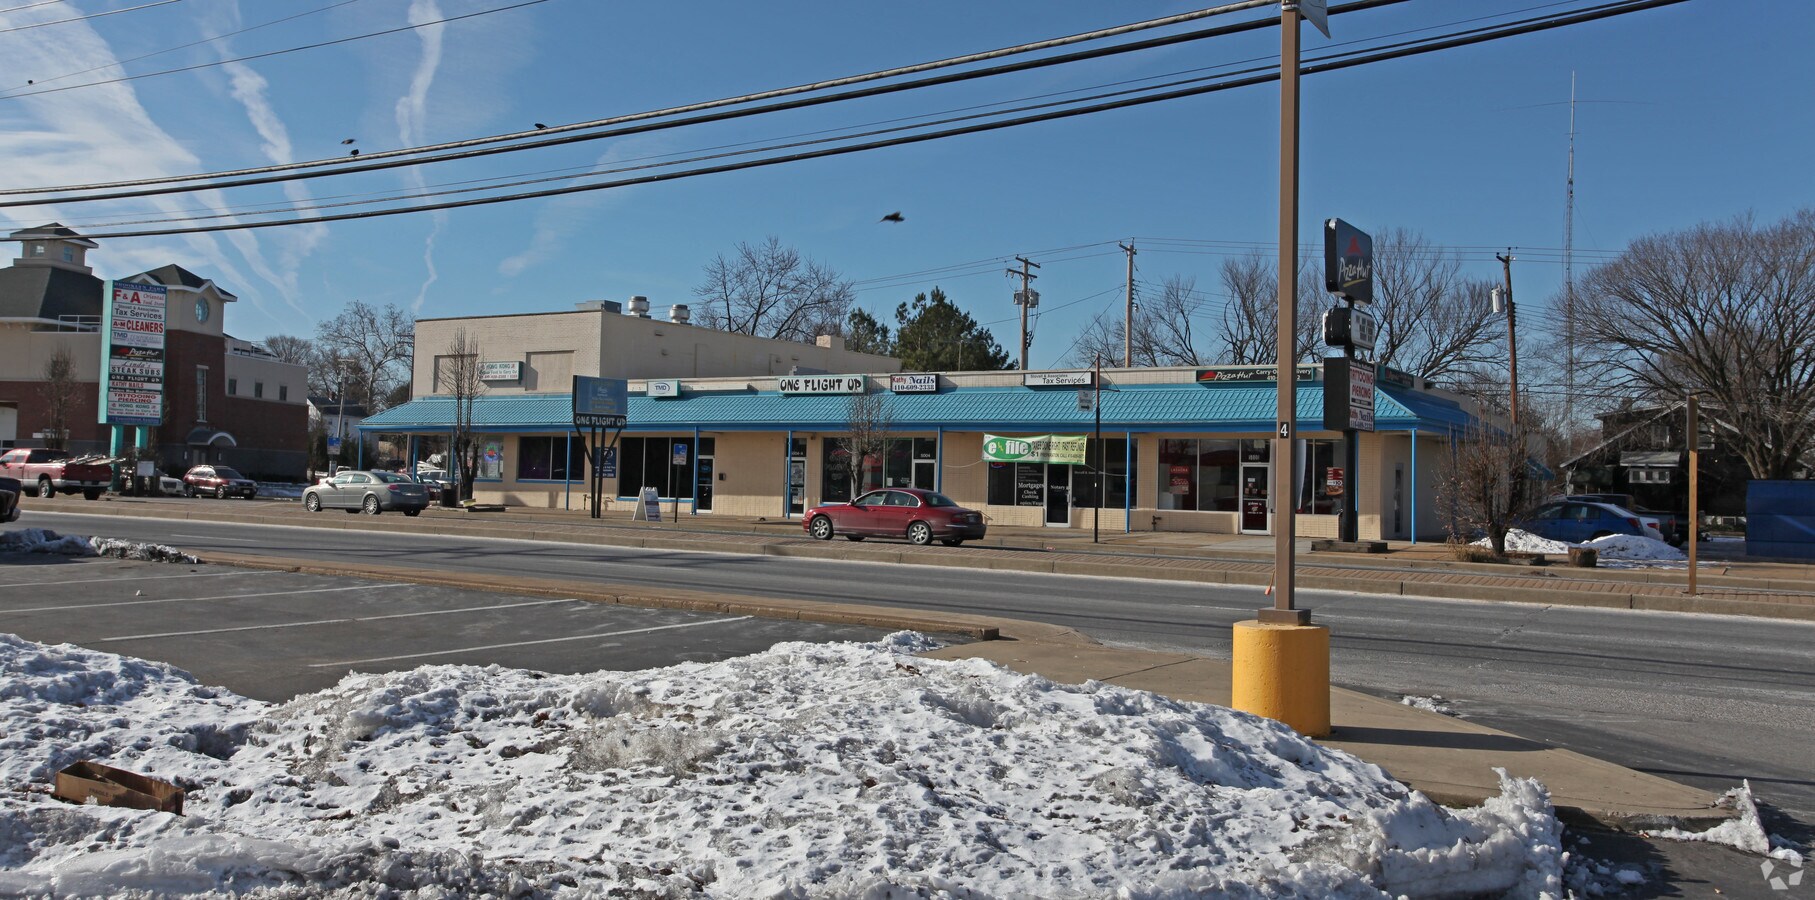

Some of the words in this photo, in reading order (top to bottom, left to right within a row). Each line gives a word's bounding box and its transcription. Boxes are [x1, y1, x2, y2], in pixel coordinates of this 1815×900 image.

[113, 289, 122, 301] F
[130, 291, 141, 304] A
[115, 307, 128, 316] Tax
[130, 309, 162, 320] Services
[126, 319, 164, 333] CLEANERS
[111, 366, 137, 374] STEAK
[139, 368, 161, 376] SUBS
[1214, 371, 1236, 380] Pizza
[1235, 371, 1254, 379] Hut
[780, 379, 800, 391] ONE
[803, 379, 843, 391] FLIGHT
[847, 379, 861, 391] UP
[909, 376, 935, 384] Nails
[1351, 384, 1371, 399] PIERCING
[576, 416, 590, 424] ONE
[592, 416, 615, 426] FLIGHT
[1280, 423, 1288, 437] 4
